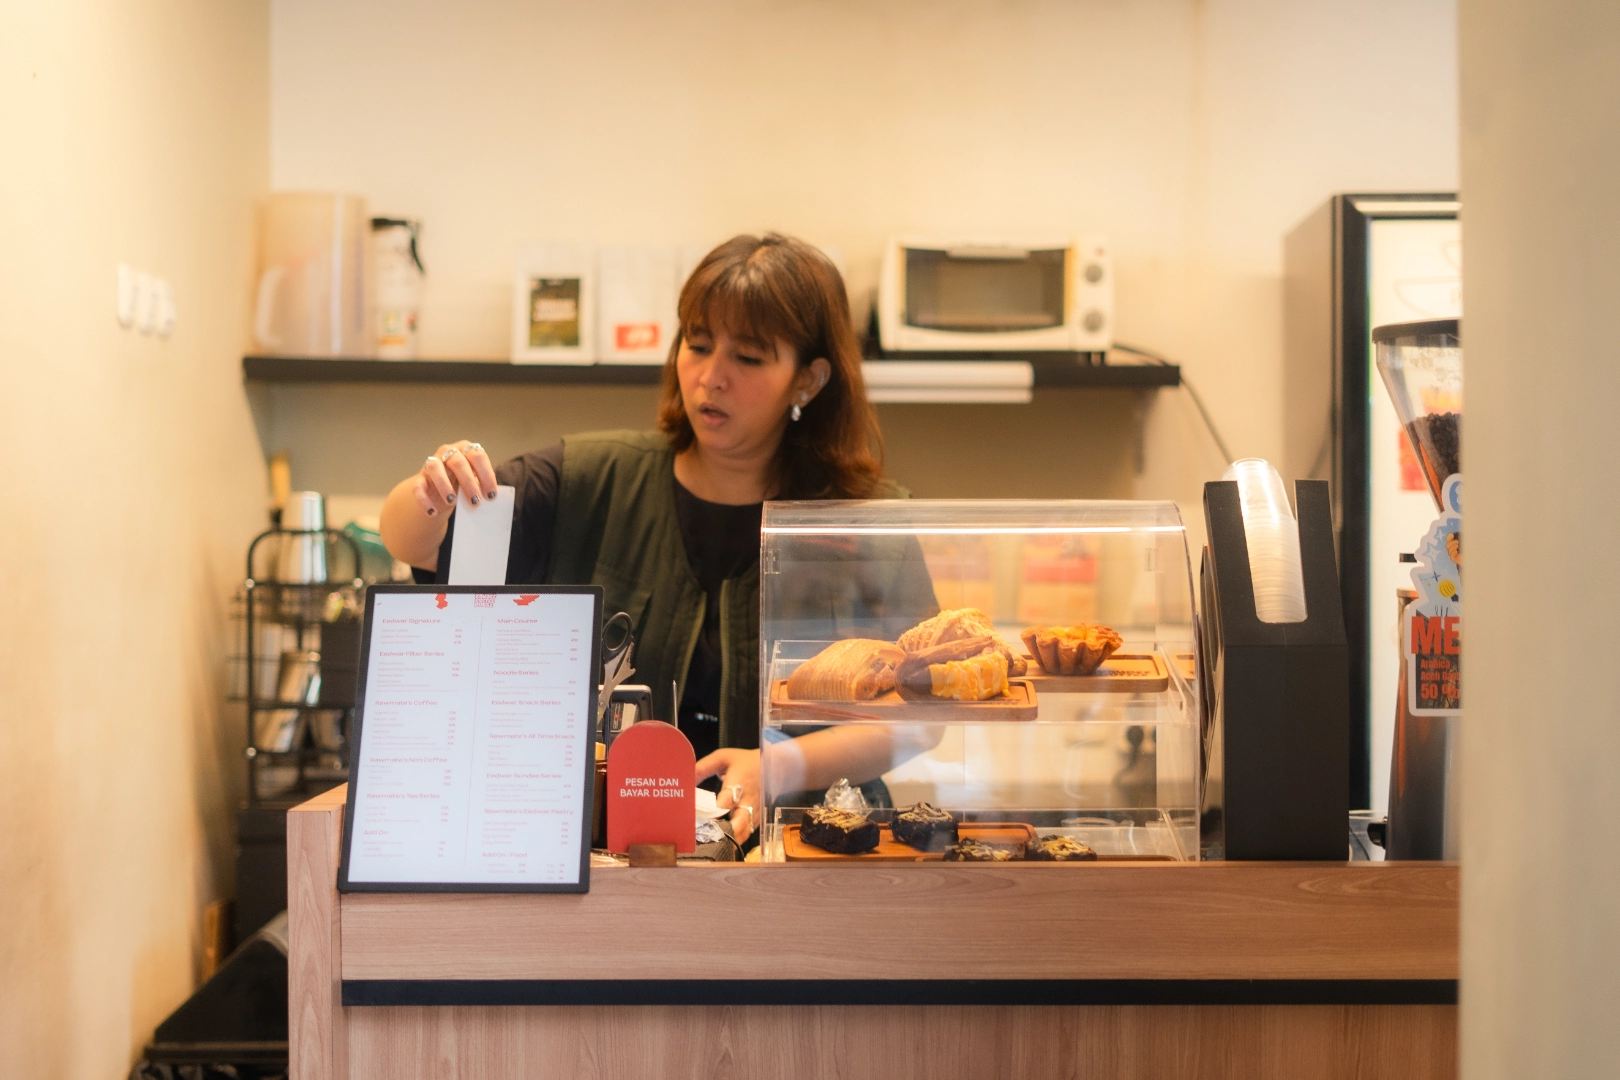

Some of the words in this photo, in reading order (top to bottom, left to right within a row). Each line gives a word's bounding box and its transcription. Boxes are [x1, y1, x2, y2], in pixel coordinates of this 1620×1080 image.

[1420, 659, 1450, 669] Arabica
[1421, 683, 1439, 700] 50
[1441, 683, 1460, 700] %
[625, 778, 656, 787] PESAN
[659, 778, 679, 787] DAN
[620, 789, 650, 797] BAYAR
[653, 789, 684, 798] DISINI
